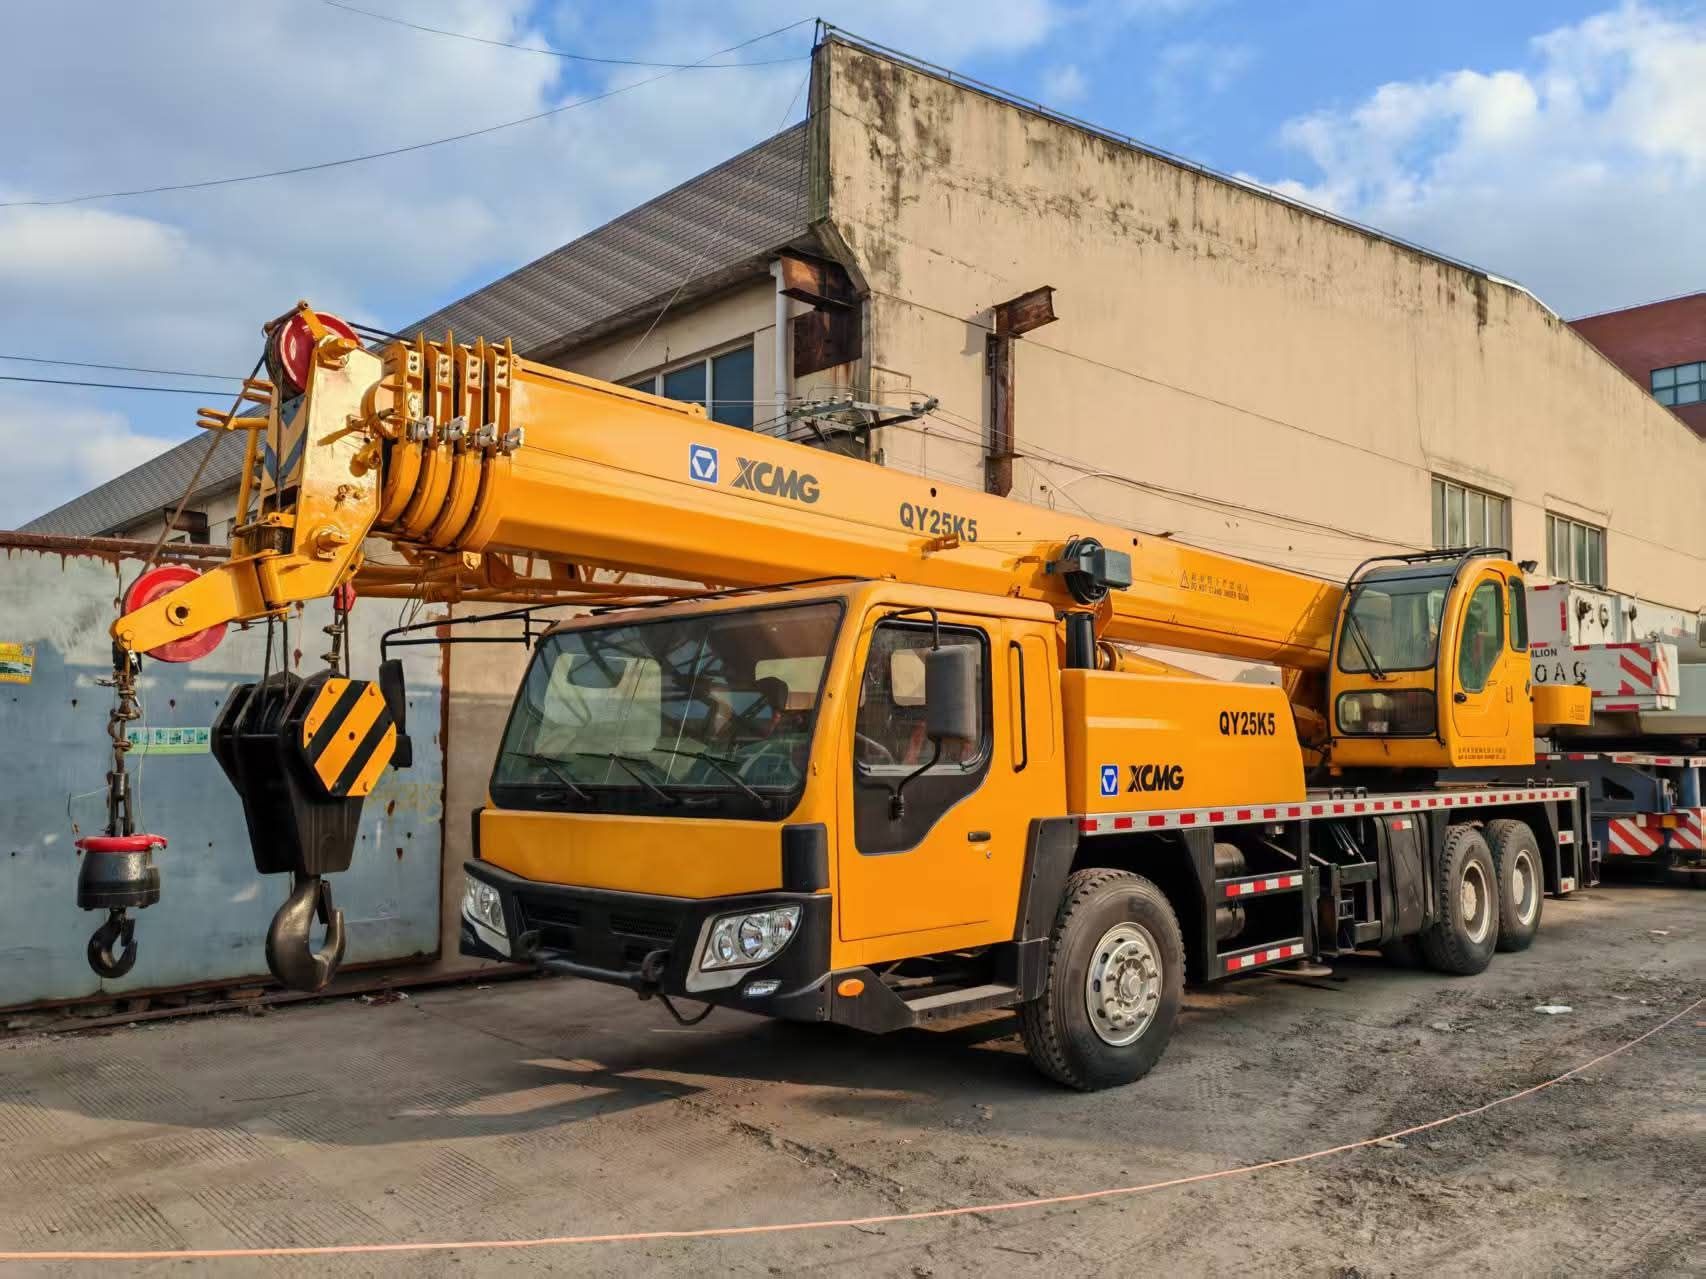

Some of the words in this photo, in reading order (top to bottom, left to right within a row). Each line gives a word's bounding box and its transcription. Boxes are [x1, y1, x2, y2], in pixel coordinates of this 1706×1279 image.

[729, 456, 820, 504] XCMG
[900, 502, 978, 543] QY25K5
[1219, 711, 1276, 736] QY25K5
[1126, 764, 1185, 792] XCMG
